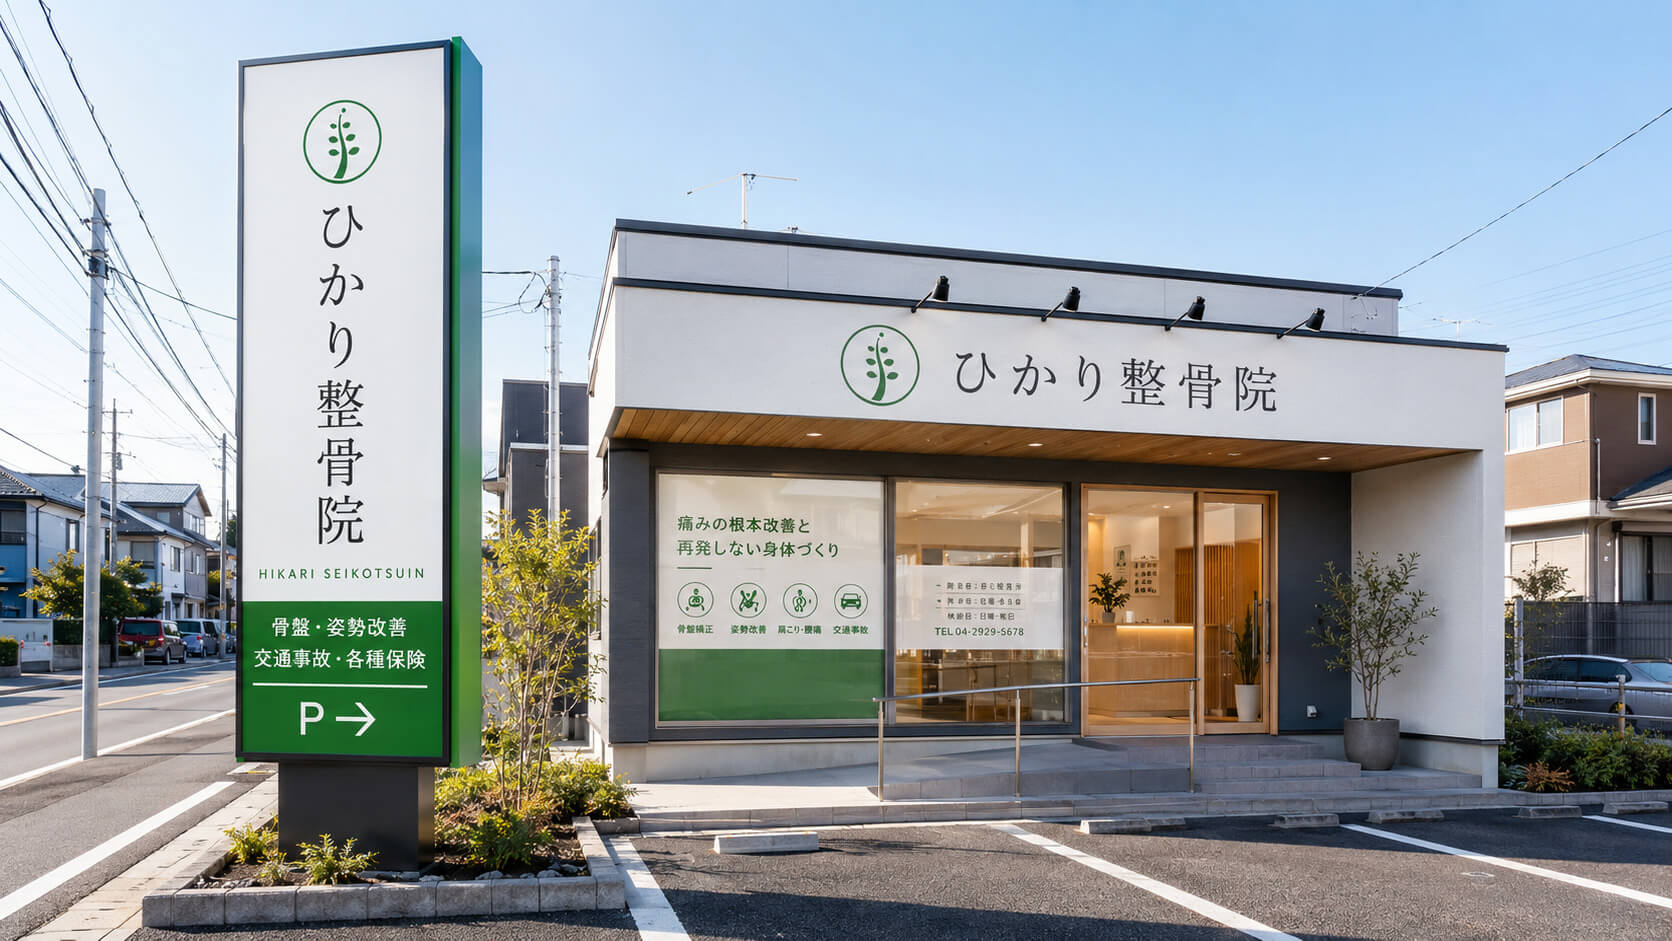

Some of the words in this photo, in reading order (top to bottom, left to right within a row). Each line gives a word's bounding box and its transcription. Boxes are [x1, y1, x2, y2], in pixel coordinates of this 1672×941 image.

[317, 204, 365, 545] ひかり整骨院
[954, 352, 1277, 412] ひかり整骨院
[677, 515, 811, 534] 痛みの根本改善と
[677, 540, 839, 558] 再発しない身体づくり
[258, 568, 314, 580] HIKARI
[323, 567, 425, 580] SEIKOTSUIN
[271, 616, 407, 638] 骨盤・姿勢改善
[934, 627, 953, 636] TEL
[955, 627, 1025, 637] 04-2929-5678
[253, 648, 427, 670] 交通事故・各種保険
[299, 701, 325, 736] P
